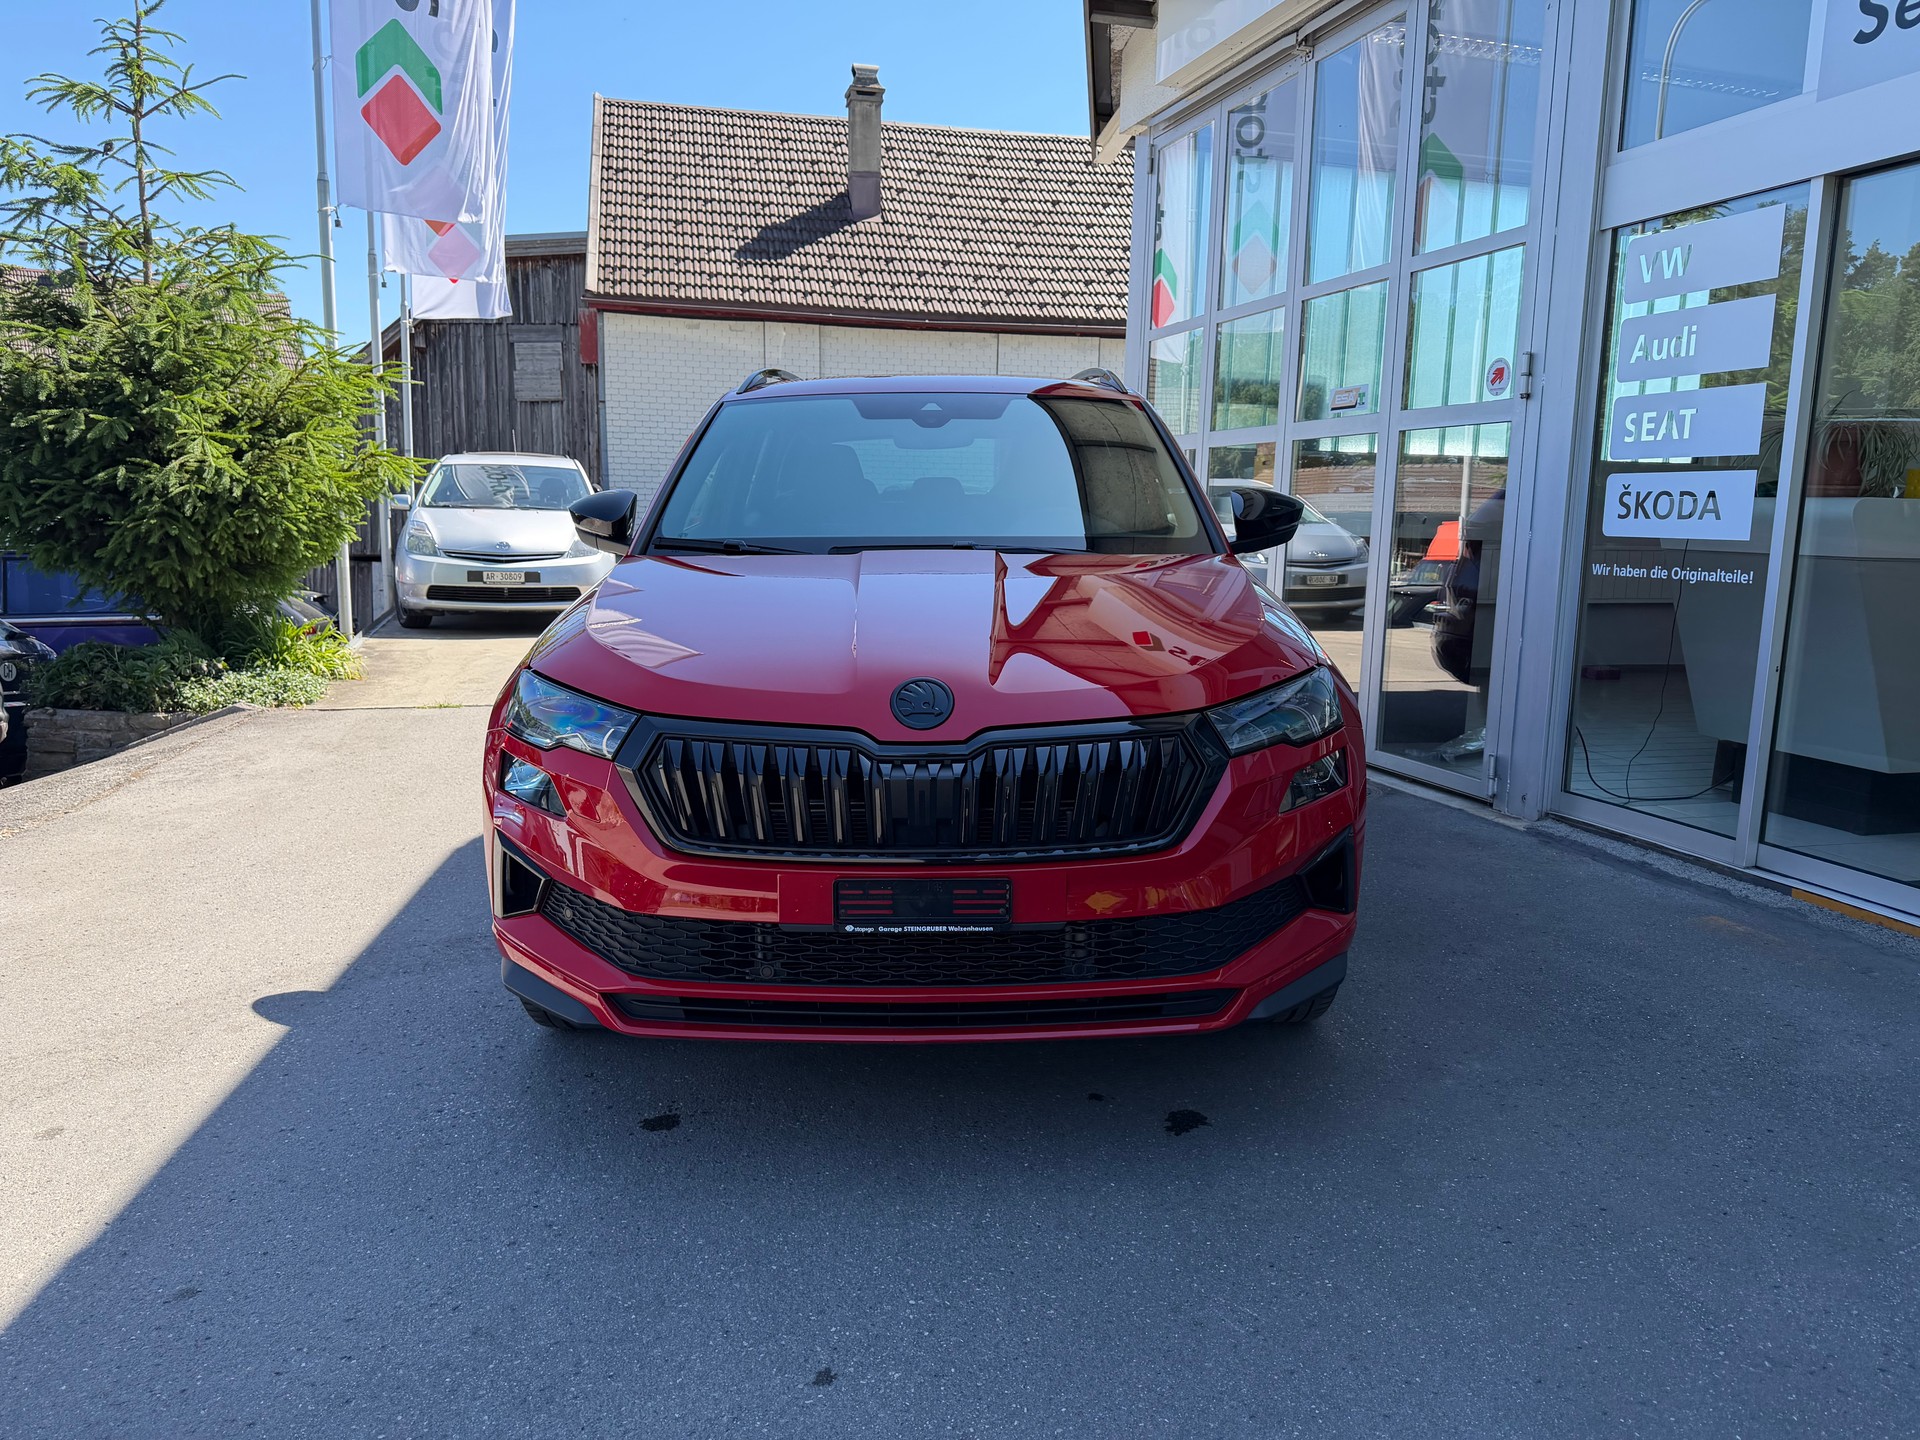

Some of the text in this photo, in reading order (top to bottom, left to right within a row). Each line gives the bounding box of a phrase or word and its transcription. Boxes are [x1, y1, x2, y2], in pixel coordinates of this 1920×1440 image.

[1639, 243, 1694, 283] VW
[1629, 325, 1698, 363] Audi
[1624, 408, 1699, 443] SEAT
[1617, 484, 1722, 521] ŠKODA
[1592, 563, 1754, 584] Wir haben die Originalteile!
